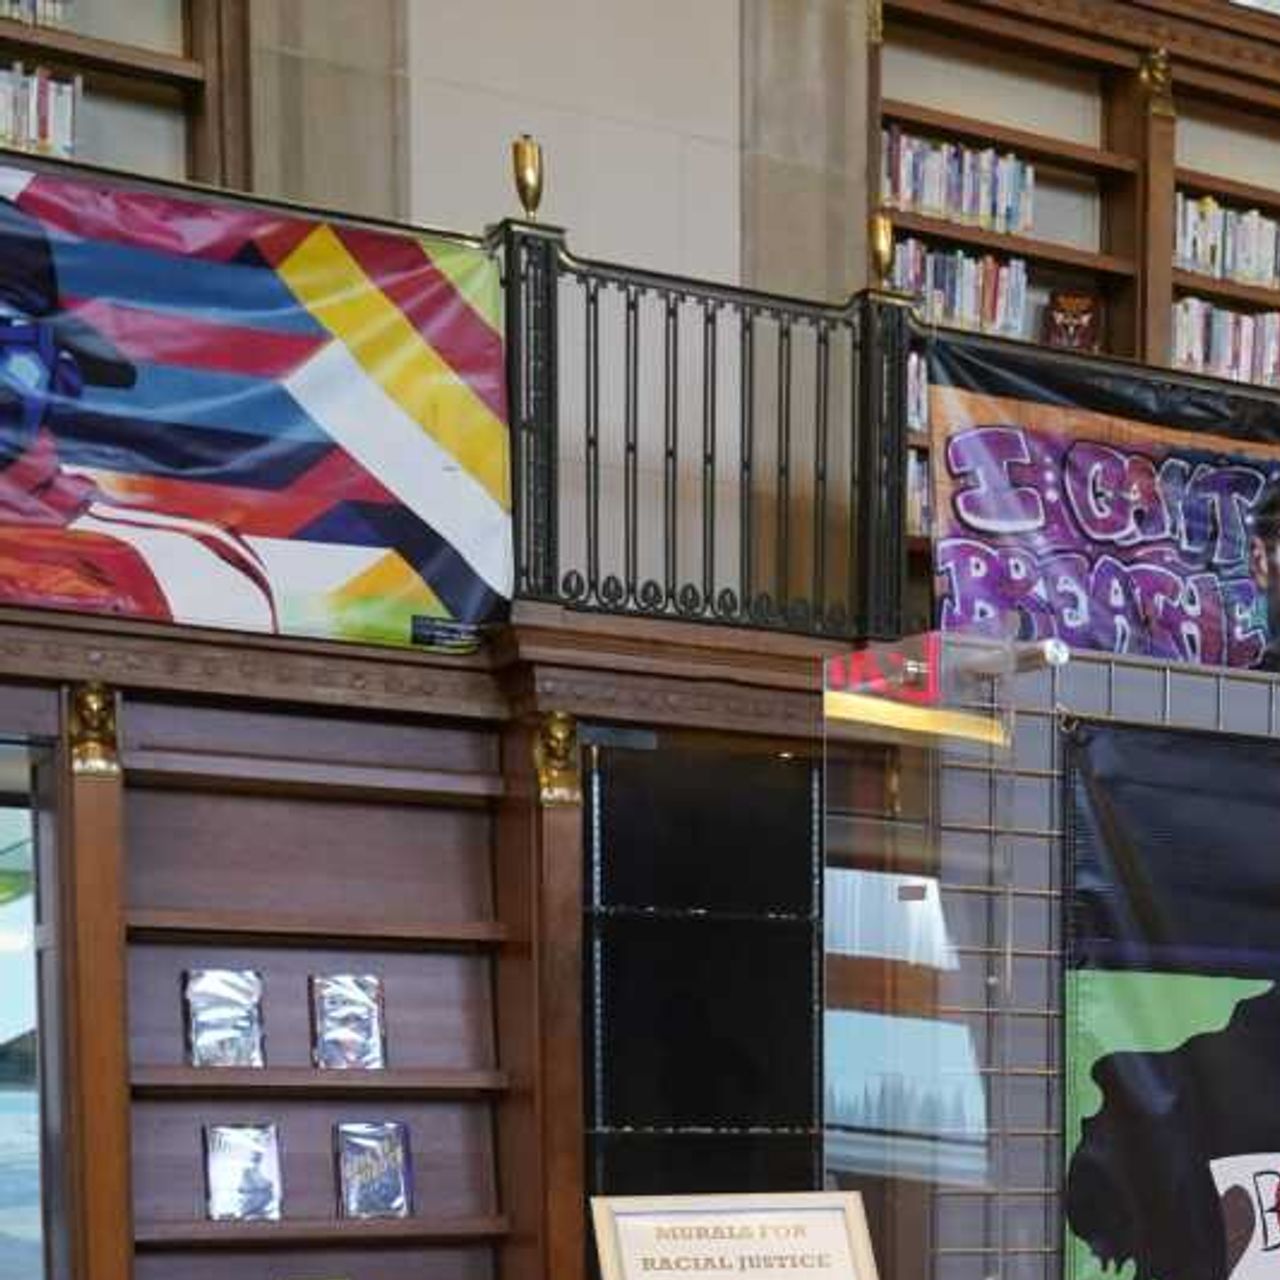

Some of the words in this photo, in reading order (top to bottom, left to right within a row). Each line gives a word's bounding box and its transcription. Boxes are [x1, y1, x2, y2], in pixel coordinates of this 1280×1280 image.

[948, 427, 1045, 533] I
[655, 1225, 755, 1240] MURALS
[758, 1224, 807, 1239] FOR
[642, 1255, 733, 1271] RACIAL
[738, 1253, 832, 1272] JUSTICE
